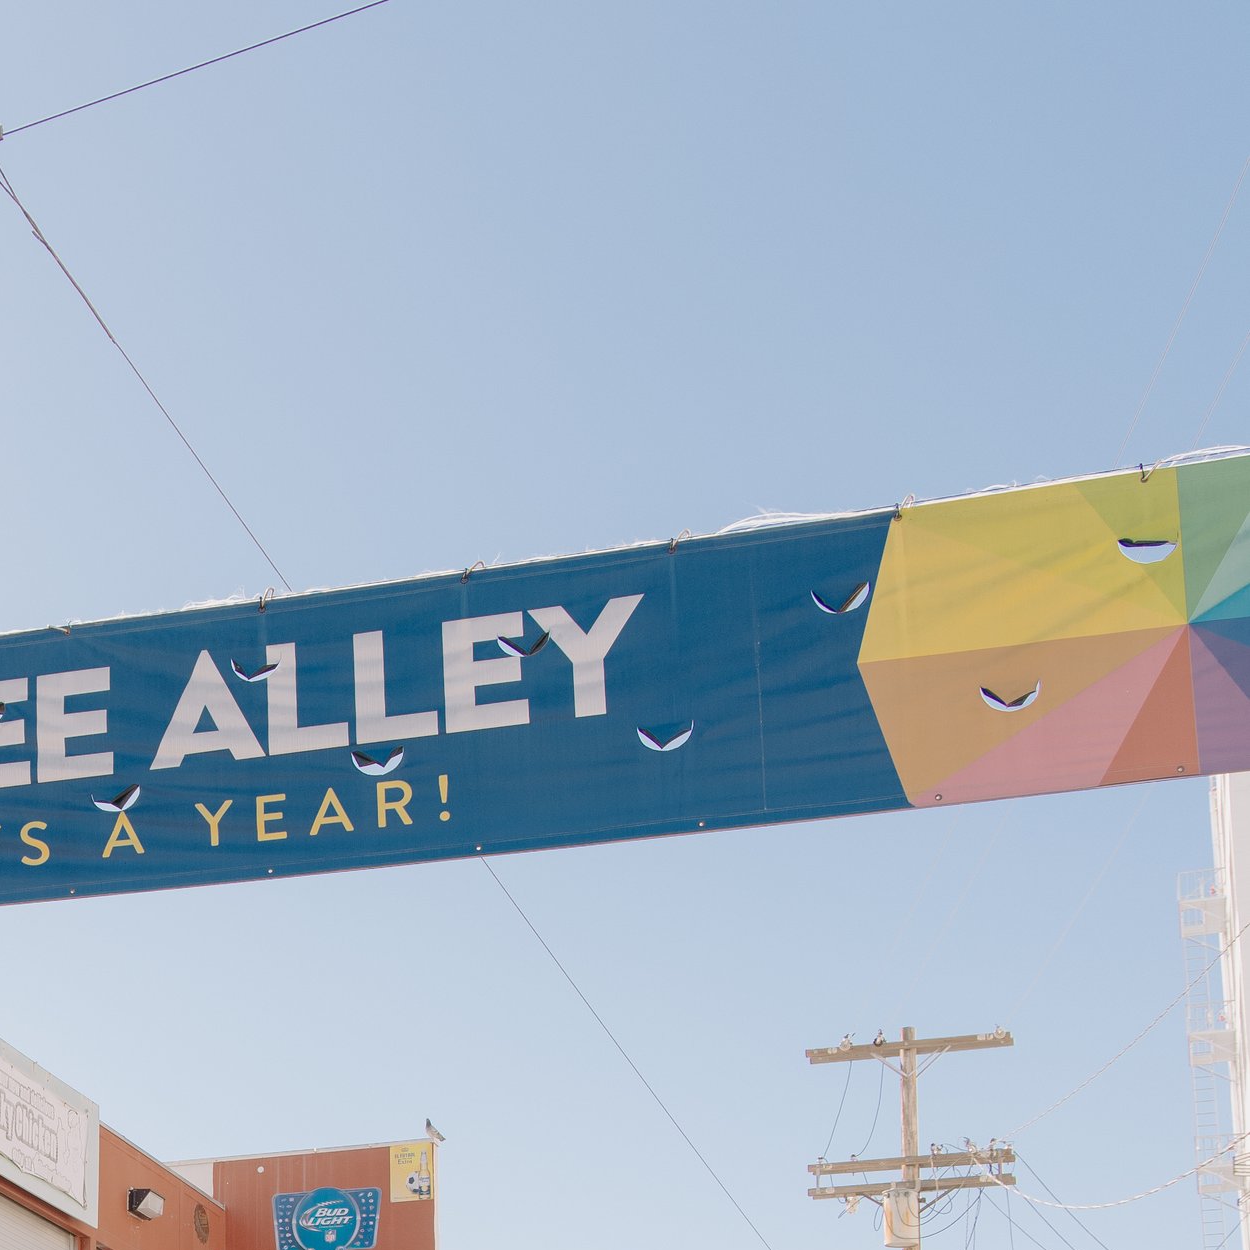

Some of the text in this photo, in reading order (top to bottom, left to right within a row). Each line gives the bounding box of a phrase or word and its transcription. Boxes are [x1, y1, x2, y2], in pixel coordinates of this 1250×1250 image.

[150, 593, 646, 771] ALLEY
[102, 811, 146, 859] A
[196, 774, 452, 848] YEAR!
[307, 1216, 354, 1226] LIGHT
[315, 1208, 349, 1217] BUD
